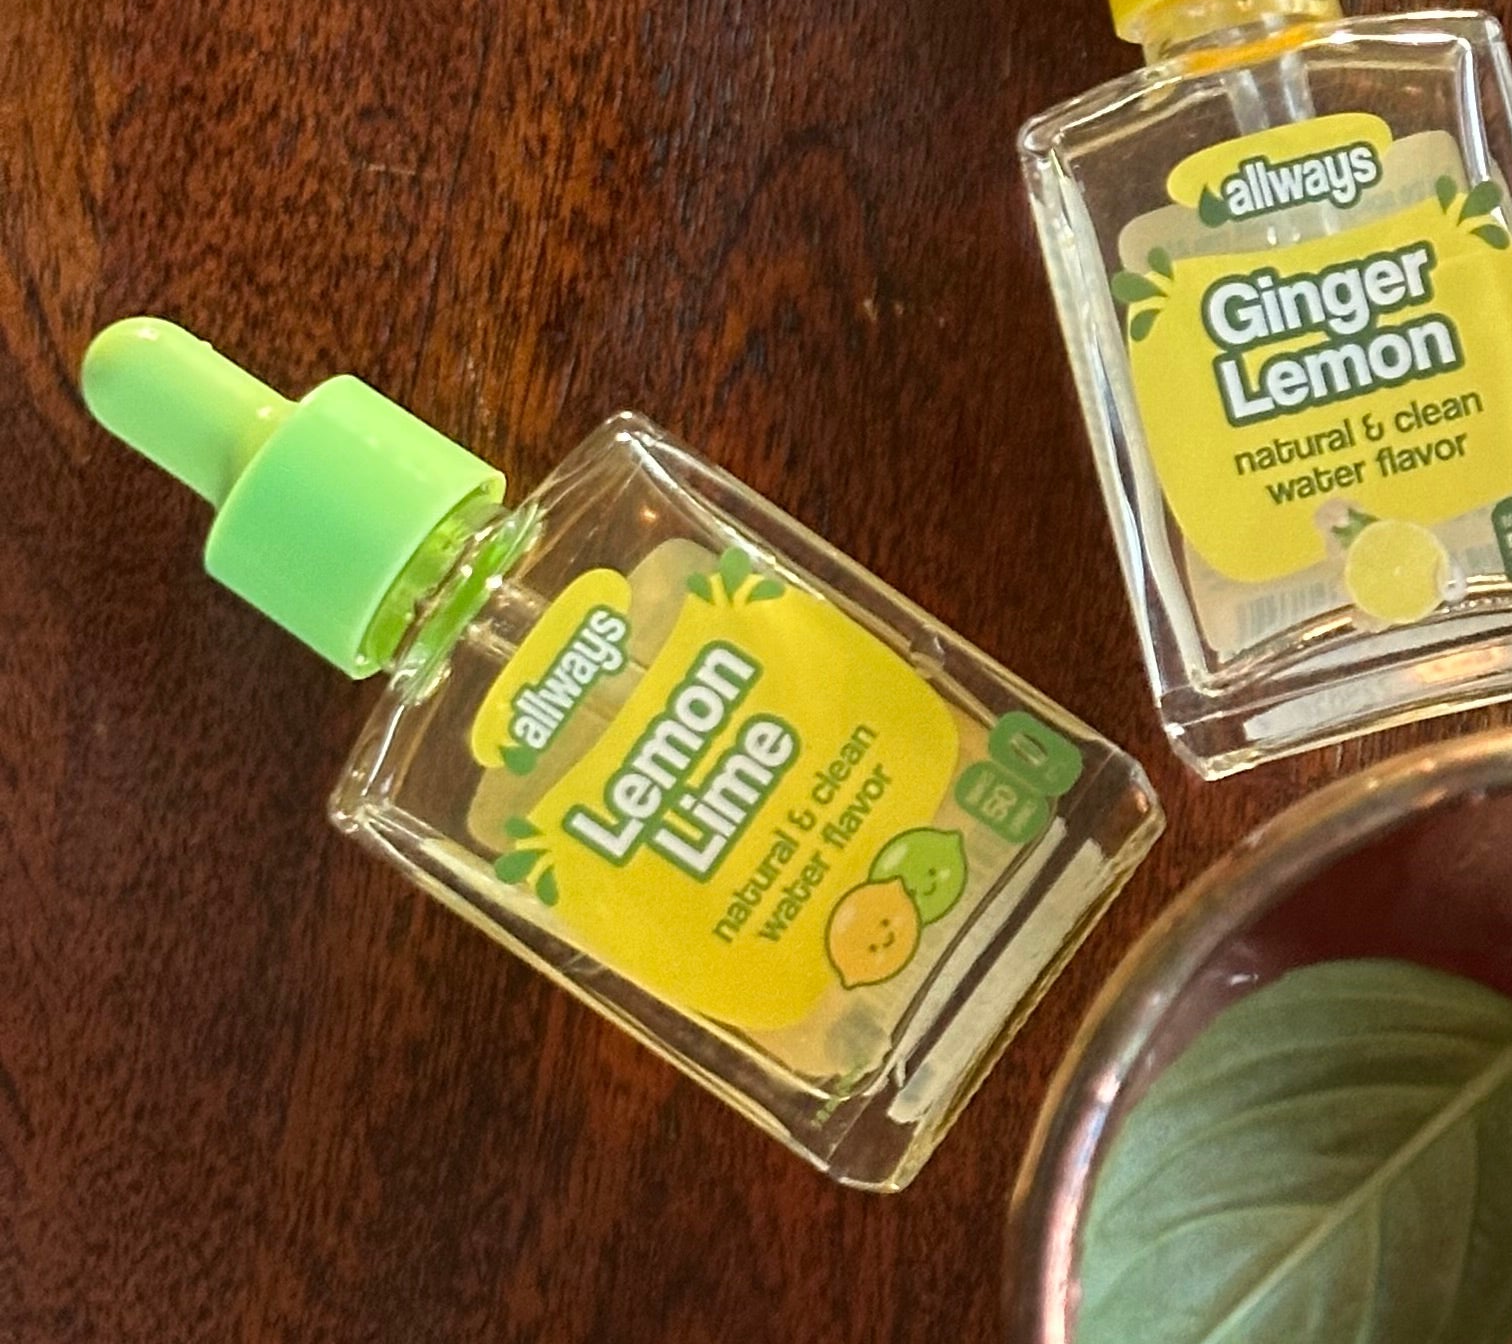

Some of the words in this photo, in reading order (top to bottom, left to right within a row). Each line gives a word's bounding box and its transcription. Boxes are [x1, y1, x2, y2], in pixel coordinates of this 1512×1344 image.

[1223, 142, 1380, 217] allways
[1207, 247, 1429, 345] Ginger
[1217, 320, 1457, 419] Lemon
[1234, 418, 1355, 476] natural
[1364, 413, 1385, 443] &
[1394, 390, 1483, 436] clean
[1265, 459, 1365, 506] water
[1375, 433, 1468, 479] flavor
[513, 609, 628, 751] allways
[569, 647, 756, 859] Lemon
[649, 720, 796, 875] Lime
[712, 827, 800, 944] natural
[811, 723, 878, 806] clean
[759, 850, 830, 943] water
[824, 765, 892, 851] flavor
